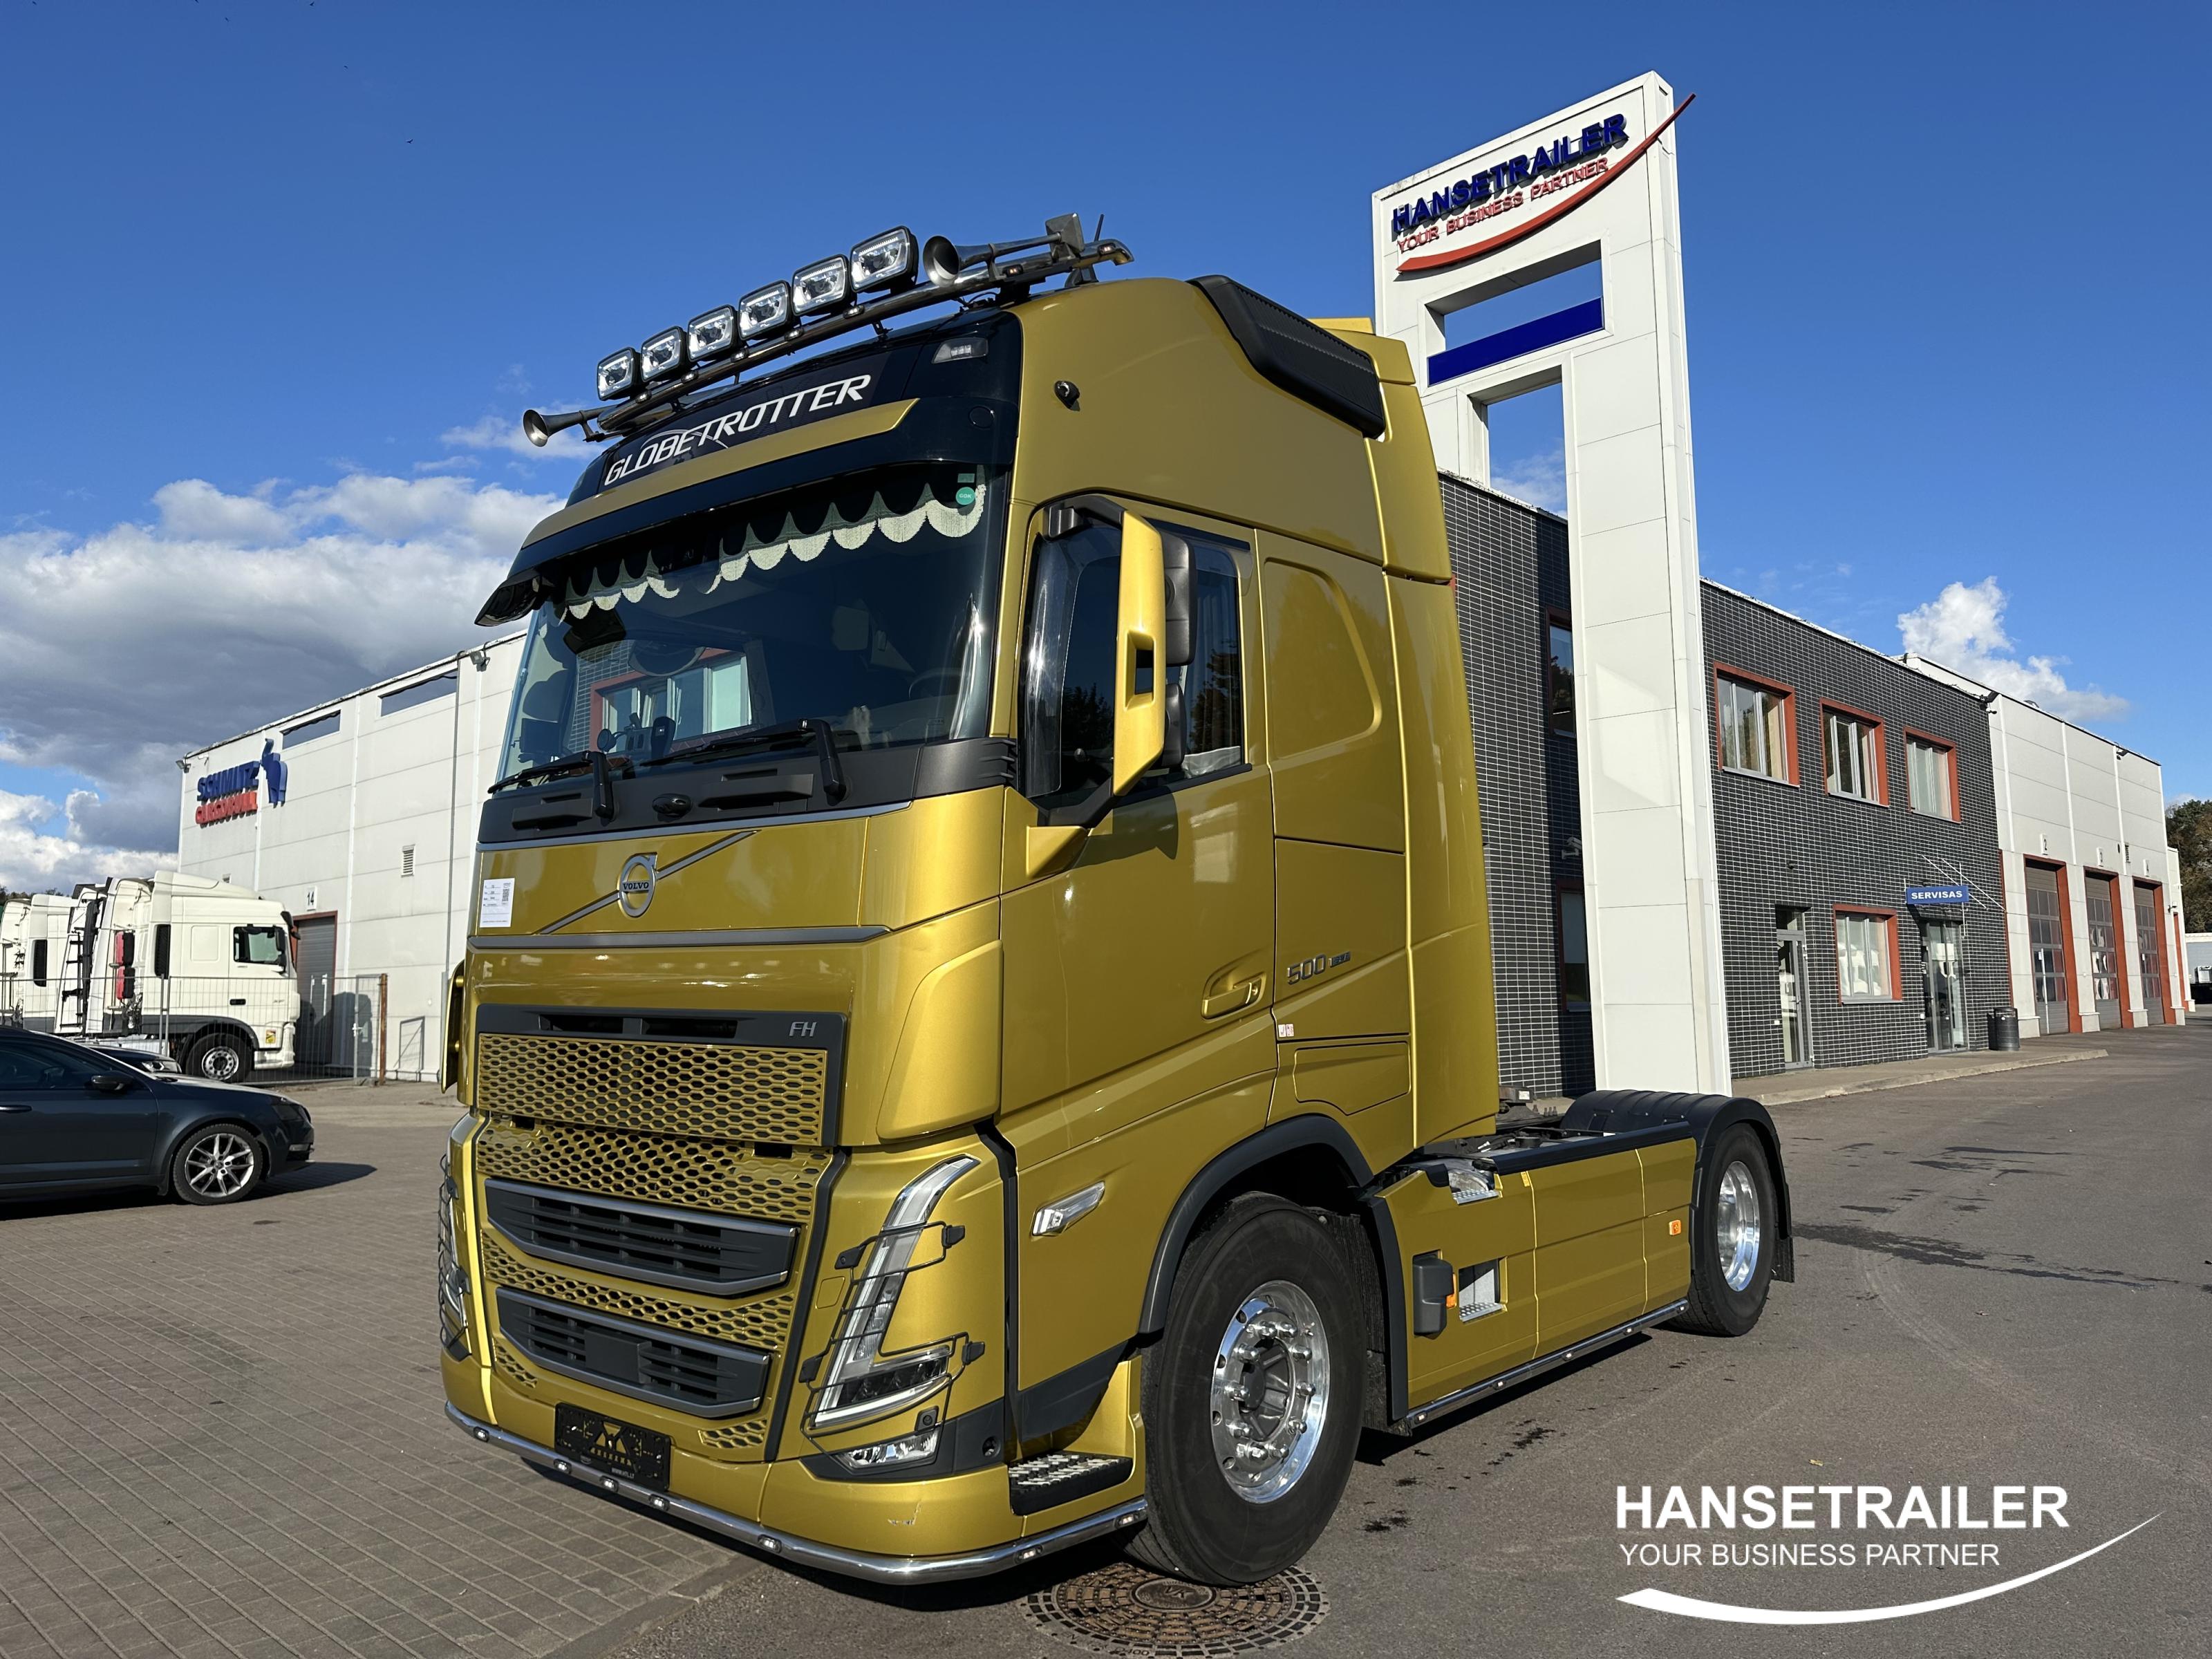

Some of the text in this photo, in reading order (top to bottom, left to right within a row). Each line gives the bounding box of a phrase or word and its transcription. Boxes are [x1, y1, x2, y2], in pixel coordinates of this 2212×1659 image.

[1392, 113, 1629, 234] HANSETRAILER
[1396, 157, 1609, 254] YOUR BUSINESS PARTNER
[604, 374, 872, 487] GLOBETROTTER
[2043, 838, 2047, 851] 2
[307, 891, 315, 906] 14
[1911, 890, 1963, 900] SERVISAS
[1287, 954, 1327, 985] 500
[789, 1022, 817, 1037] FH
